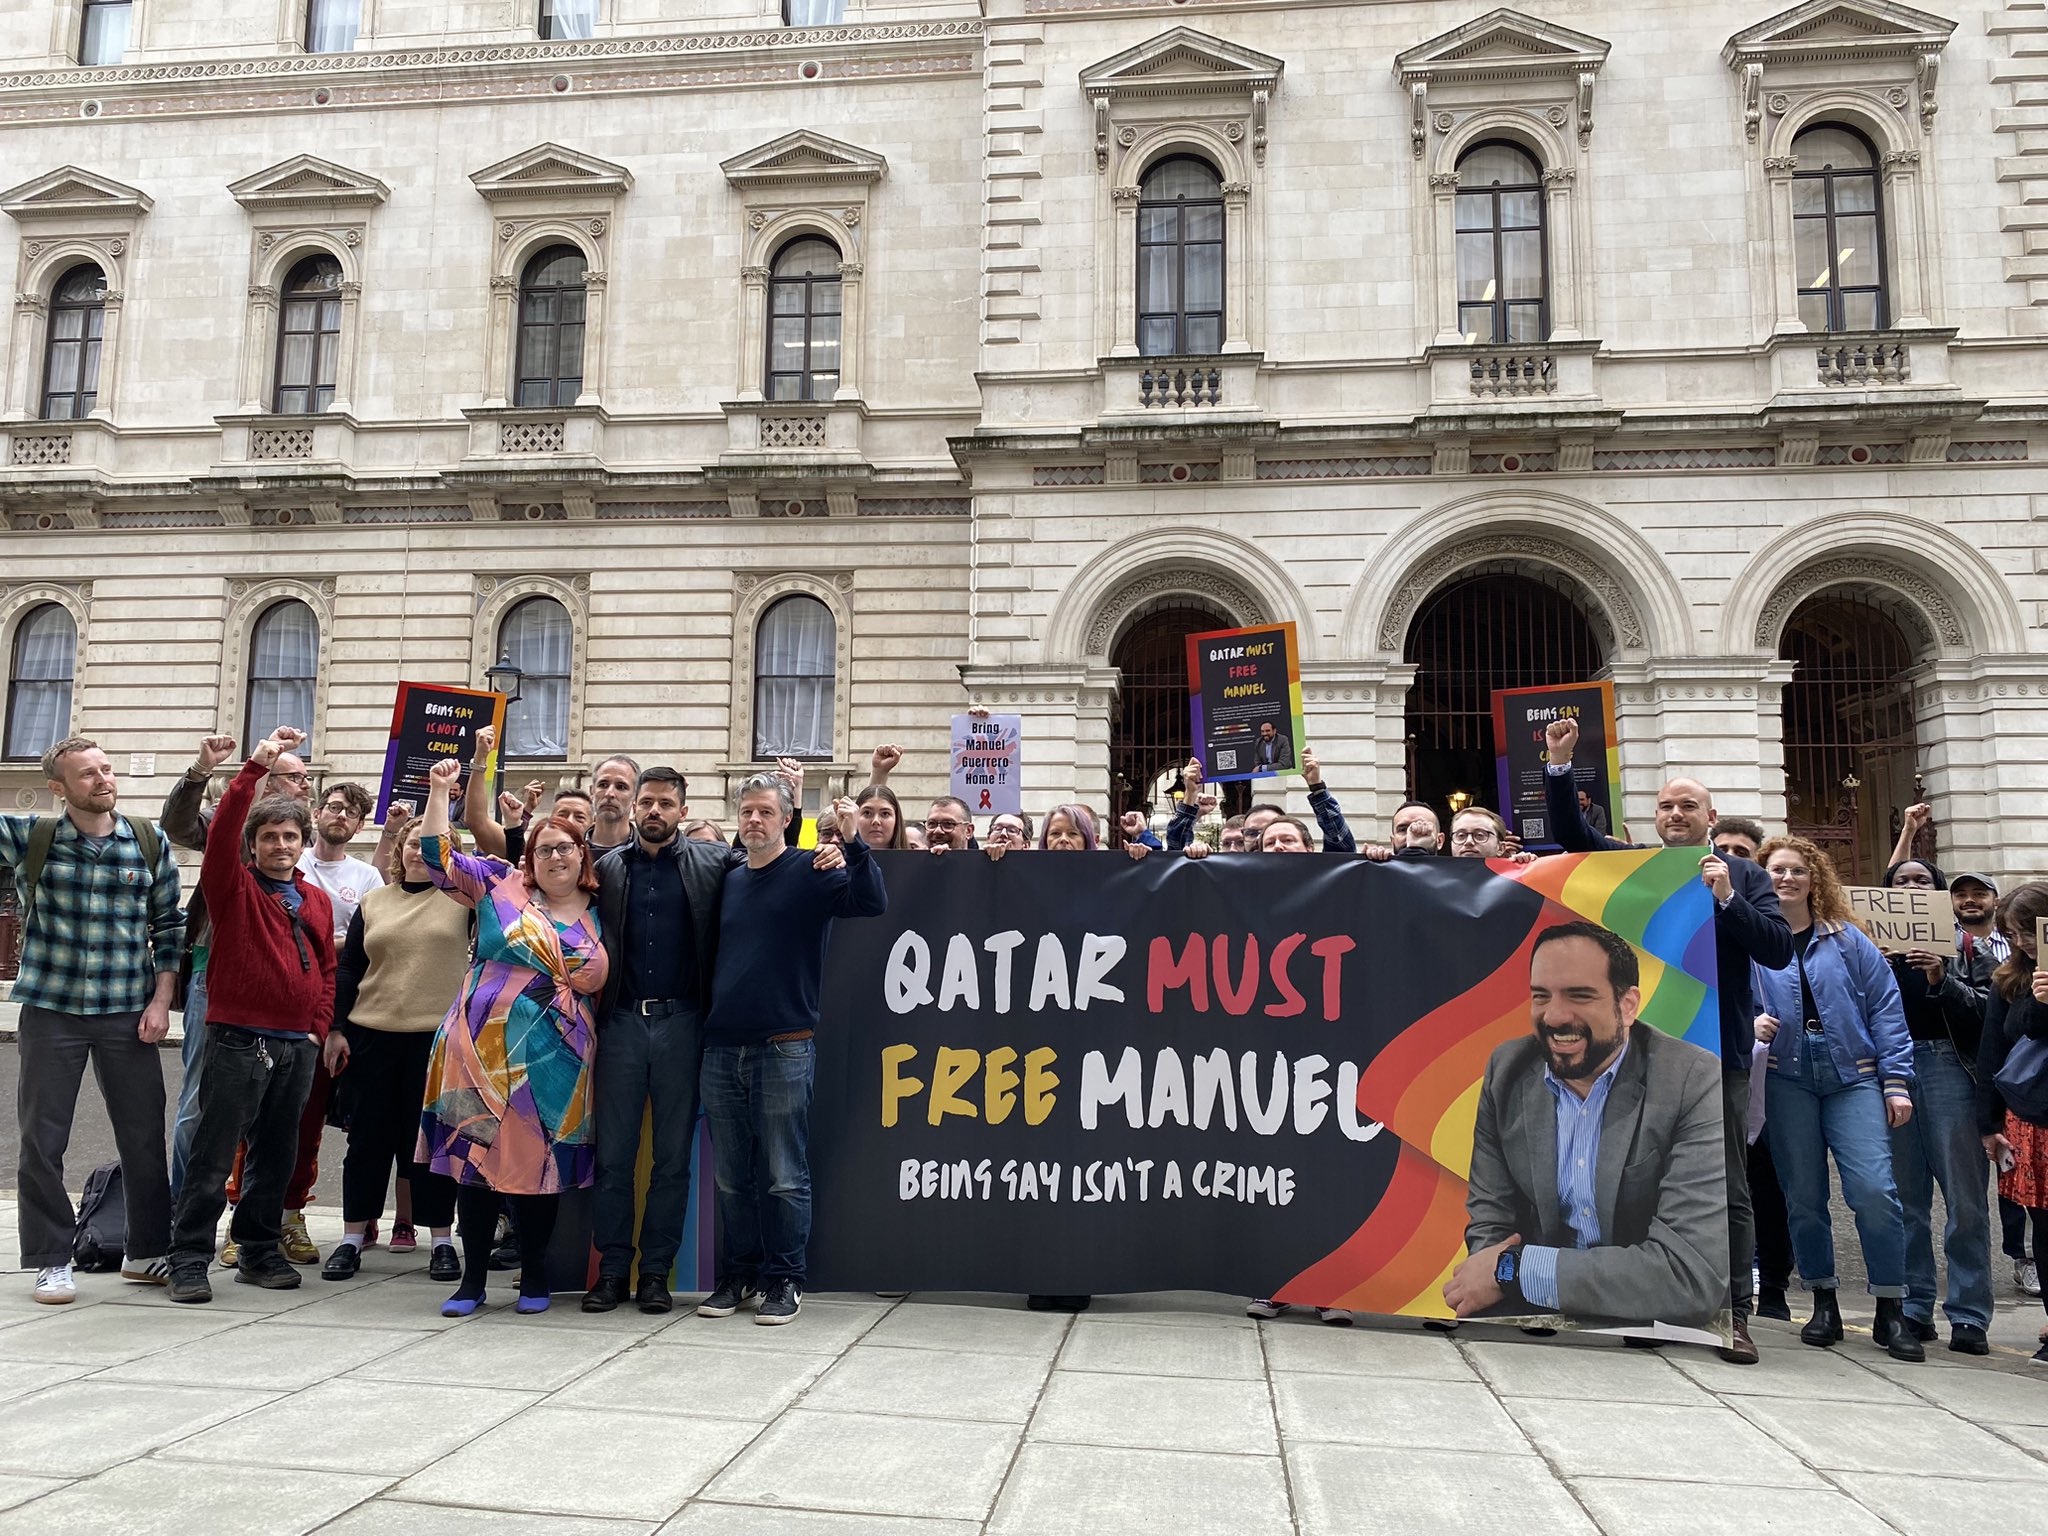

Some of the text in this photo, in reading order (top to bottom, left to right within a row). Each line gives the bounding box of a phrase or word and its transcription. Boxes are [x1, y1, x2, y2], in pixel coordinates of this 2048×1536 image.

[1210, 643, 1274, 662] QATAR MUST
[1229, 664, 1258, 678] FREE
[1224, 683, 1266, 698] MANUEL
[425, 703, 474, 719] BEING GAY
[1527, 706, 1580, 721] BEING GAY
[426, 722, 466, 736] IS NOT A
[972, 723, 999, 734] Bring
[1533, 729, 1543, 741] IS
[427, 742, 460, 754] CRIME
[966, 740, 1005, 750] Manuel
[962, 757, 1008, 767] Guerrero
[966, 774, 994, 784] Home
[1850, 890, 1929, 915] FREE
[1866, 920, 1950, 943] NUEL
[884, 930, 1356, 1021] QATAR MUST
[881, 1044, 1384, 1142] FREE MANUEL
[900, 1157, 1296, 1206] BEING GAY ISN'T A CRIME
